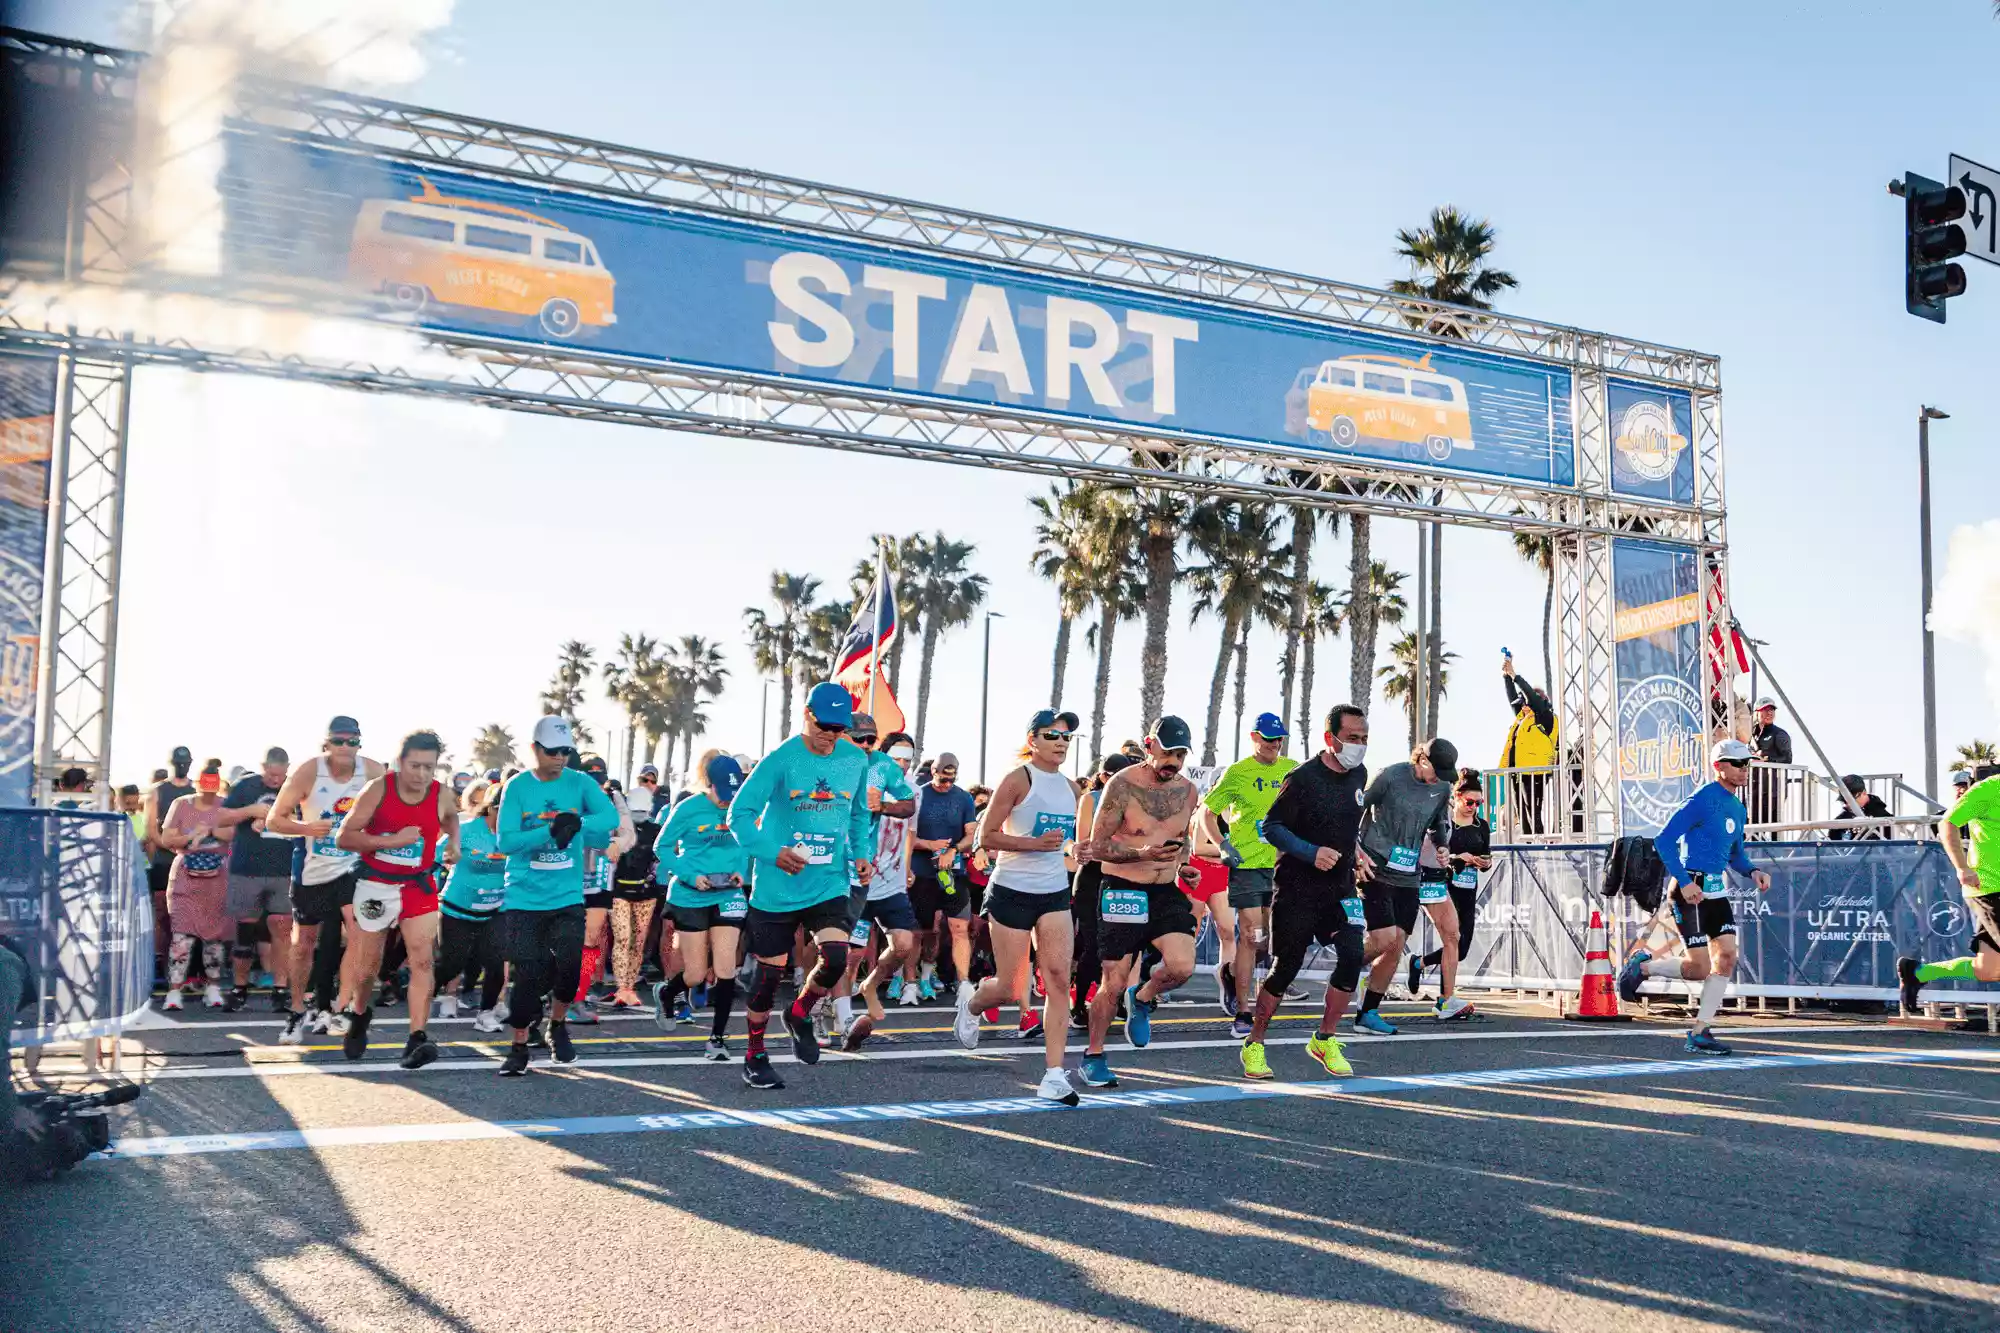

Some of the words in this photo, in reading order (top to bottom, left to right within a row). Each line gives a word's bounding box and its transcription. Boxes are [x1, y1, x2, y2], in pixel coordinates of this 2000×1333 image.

[767, 251, 1199, 416] START
[1622, 719, 1668, 782] Surf
[1668, 723, 1704, 787] City
[1188, 767, 1205, 779] YAY
[1628, 785, 1673, 822] MARAT
[1108, 902, 1140, 914] 8298
[1729, 900, 1772, 916] TRA
[1819, 894, 1874, 907] Michelob
[1807, 909, 1890, 927] ULTRA
[1807, 931, 1851, 941] ORGANIC
[1852, 931, 1891, 942] SELTZER
